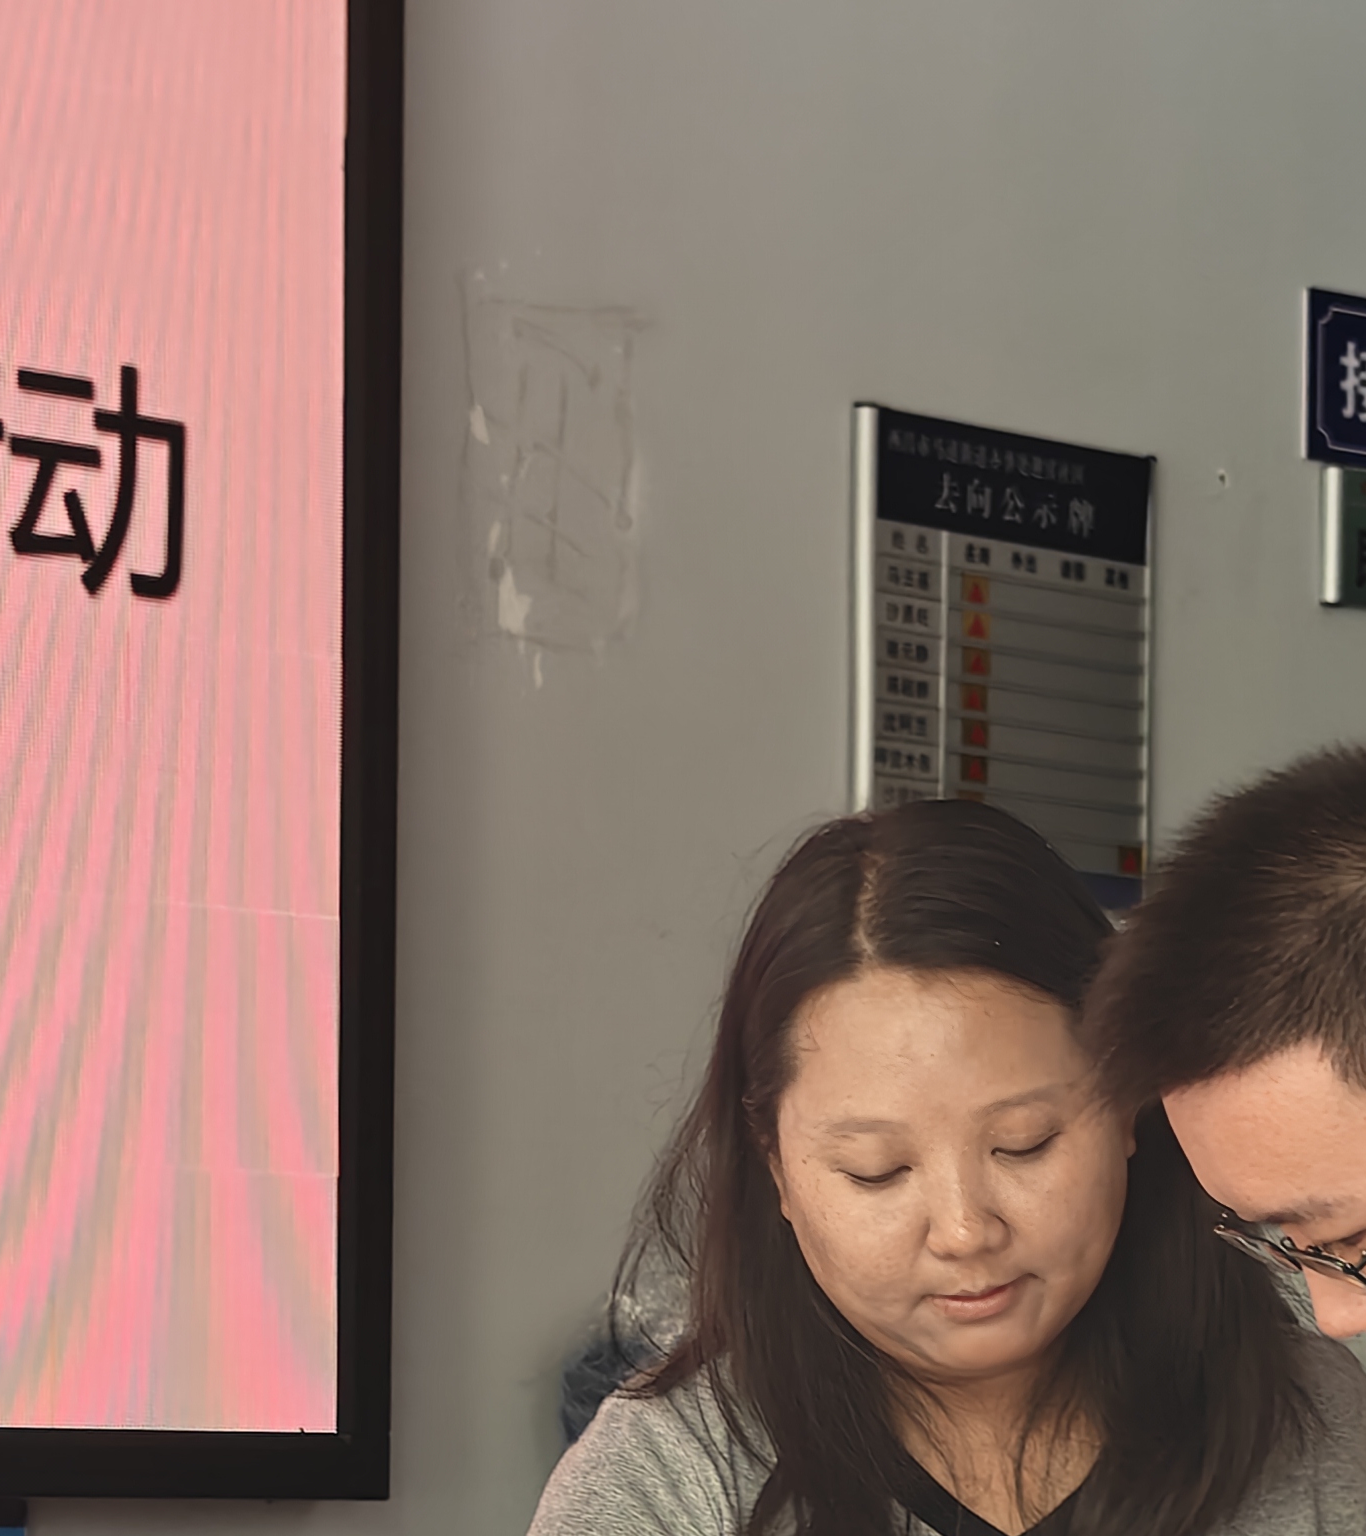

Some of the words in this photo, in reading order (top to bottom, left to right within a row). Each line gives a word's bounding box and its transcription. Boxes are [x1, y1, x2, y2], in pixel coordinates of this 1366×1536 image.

[934, 471, 1096, 538] 去向公示牌
